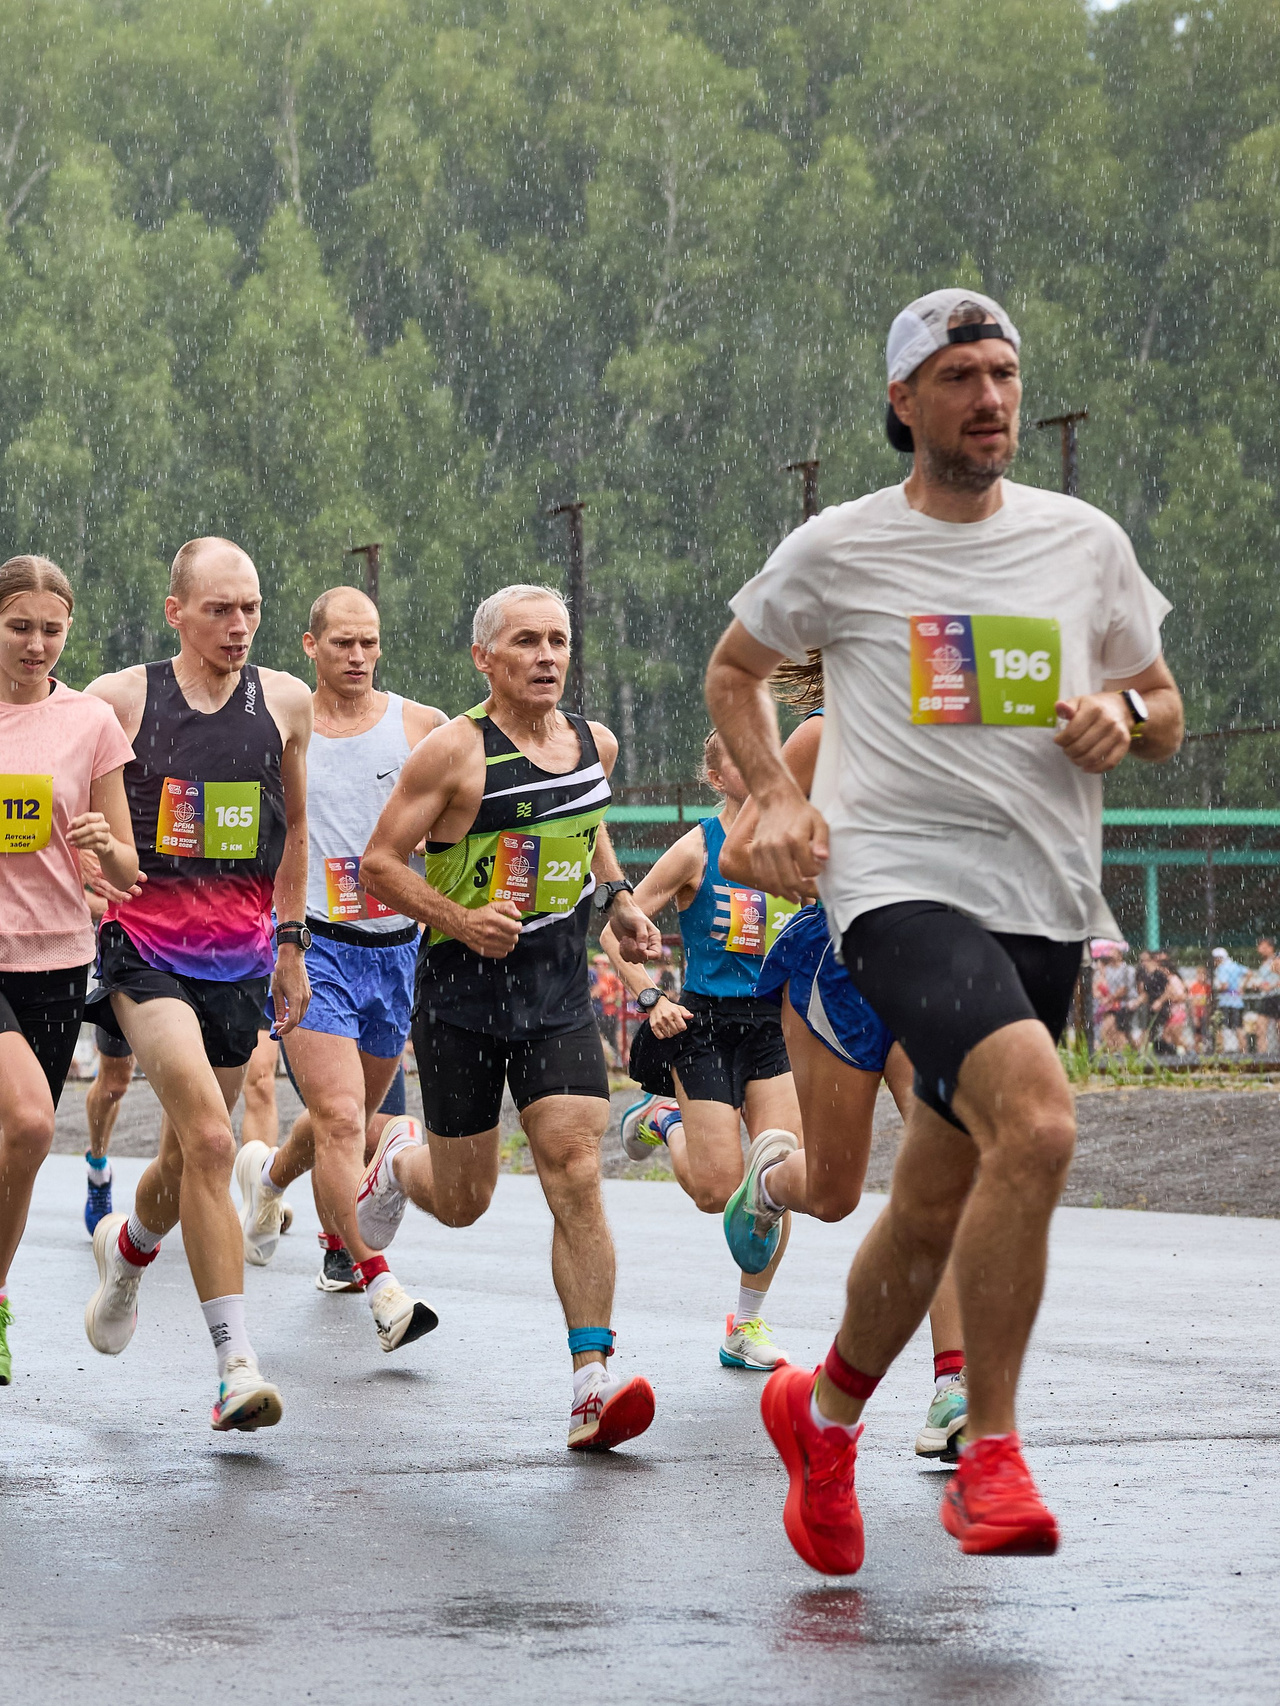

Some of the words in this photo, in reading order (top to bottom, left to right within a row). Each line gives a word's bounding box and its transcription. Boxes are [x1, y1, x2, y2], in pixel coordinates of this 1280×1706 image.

[989, 648, 1051, 682] 196
[1003, 700, 1013, 714] 5
[2, 798, 40, 820] 112
[215, 806, 253, 828] 165
[173, 822, 195, 830] АРЕНА
[4, 833, 36, 842] Детский
[162, 835, 178, 847] 28
[221, 842, 227, 851] 5
[543, 861, 582, 882] 224
[507, 875, 528, 883] АРЕНА
[495, 888, 511, 900] 28
[549, 896, 556, 905] 5
[332, 905, 346, 915] 28
[377, 904, 387, 912] 10
[732, 935, 746, 945] 28
